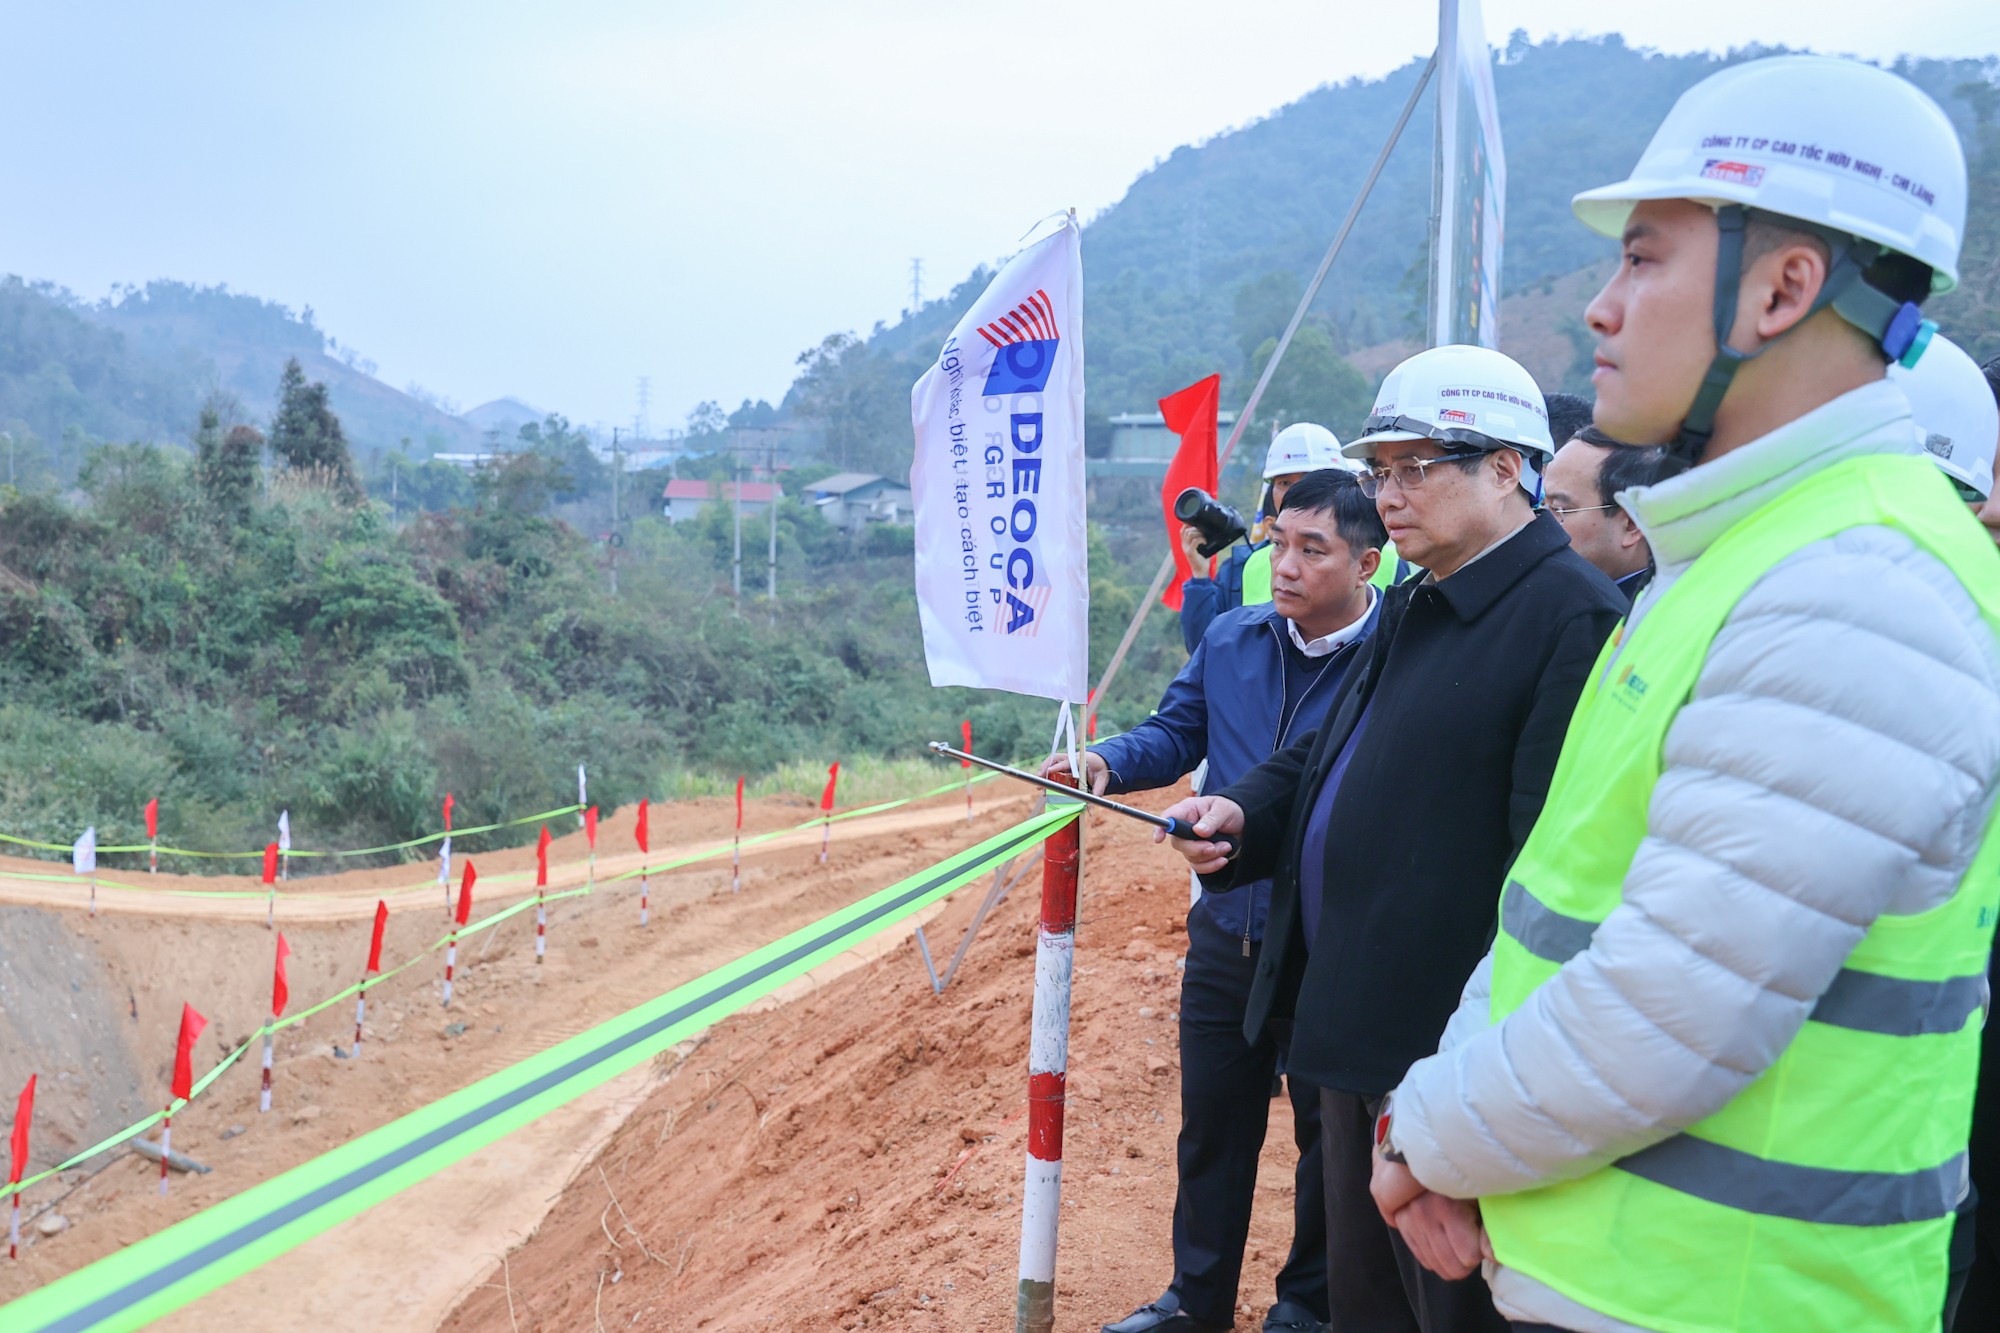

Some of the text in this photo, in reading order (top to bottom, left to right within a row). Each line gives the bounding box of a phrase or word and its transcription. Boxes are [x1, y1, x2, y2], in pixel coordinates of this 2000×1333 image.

[1701, 135, 1732, 148] CÔNG
[1735, 137, 1749, 148] TY
[1752, 138, 1769, 150] CP
[1771, 140, 1796, 155] CAO
[941, 337, 964, 385] Nghĩ
[1441, 389, 1460, 397] CÔNG
[1462, 389, 1470, 397] TY
[1471, 389, 1481, 397] CP
[1482, 390, 1495, 399] CAO
[953, 484, 969, 519] tạo
[1006, 412, 1043, 634] DEOCA
[984, 445, 1007, 604] GROUP
[961, 528, 979, 580] cách
[965, 591, 983, 633] biệt
